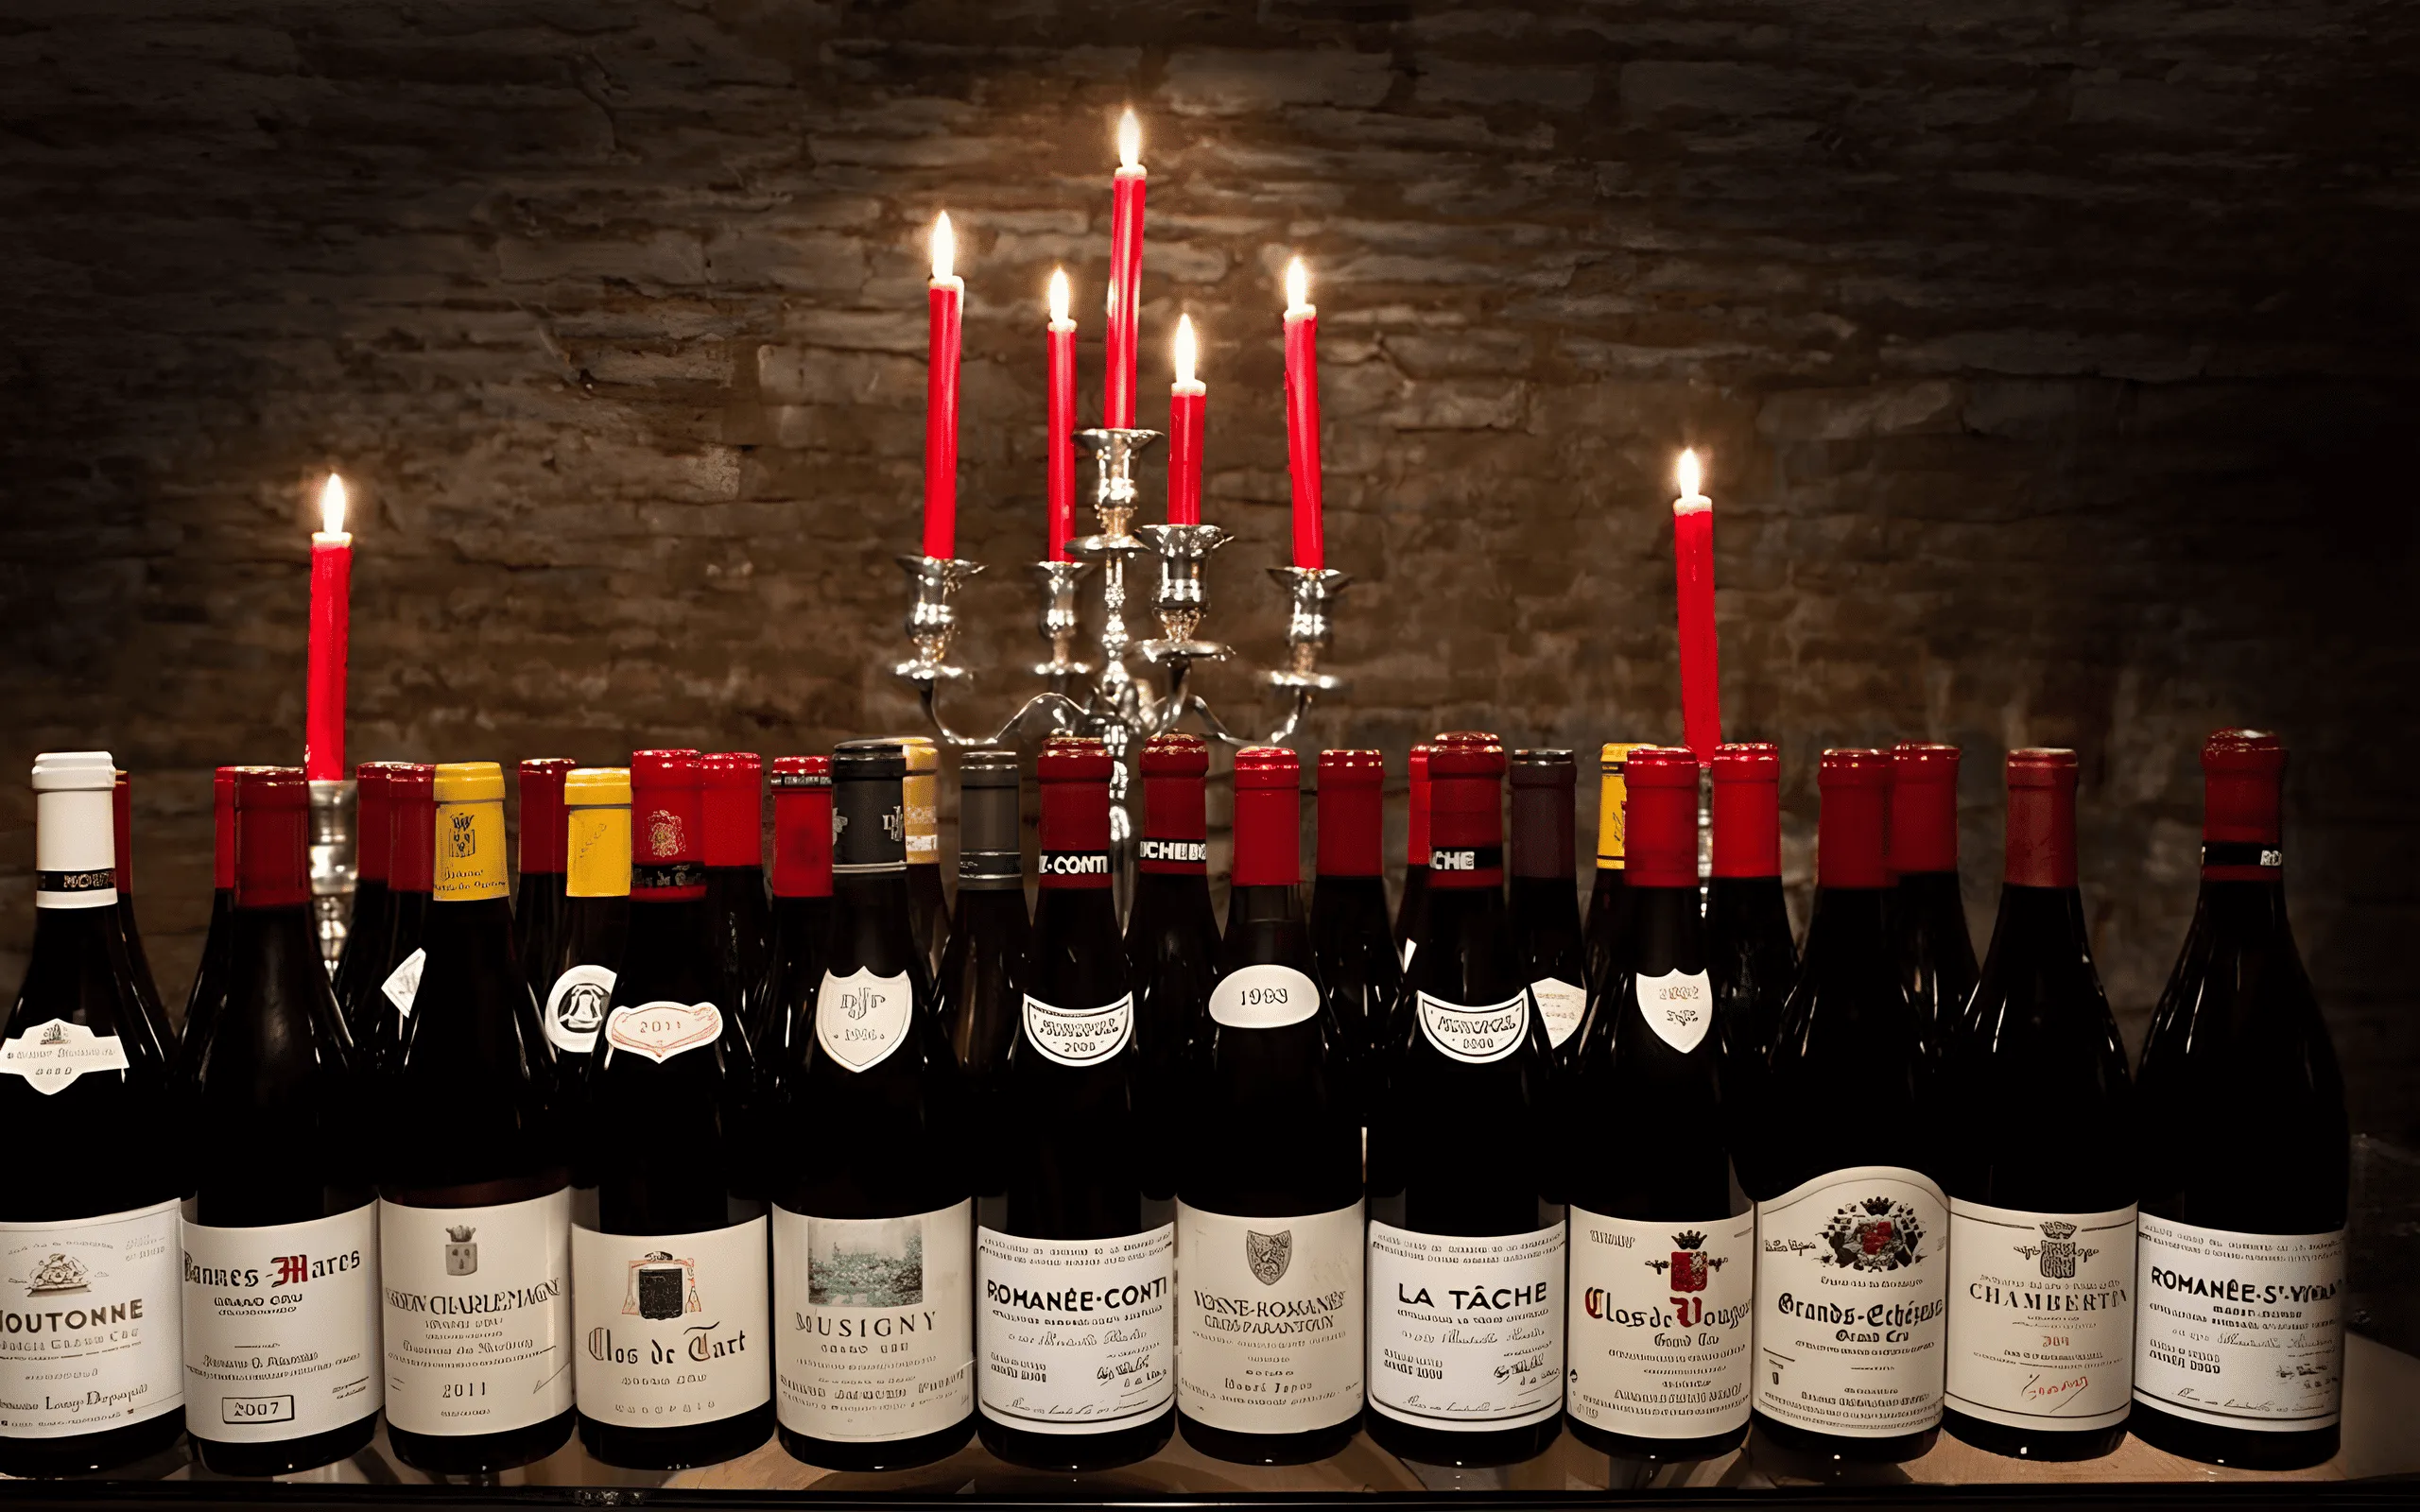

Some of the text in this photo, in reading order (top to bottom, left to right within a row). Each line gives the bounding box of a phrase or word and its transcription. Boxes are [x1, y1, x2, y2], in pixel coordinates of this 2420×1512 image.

[1398, 1280, 1547, 1310] LA TÂCHE
[1584, 1286, 1647, 1328] Clos
[588, 1327, 638, 1364] Clos
[651, 1339, 676, 1365] de
[683, 1321, 746, 1362] Tart
[442, 1382, 486, 1399] 2011
